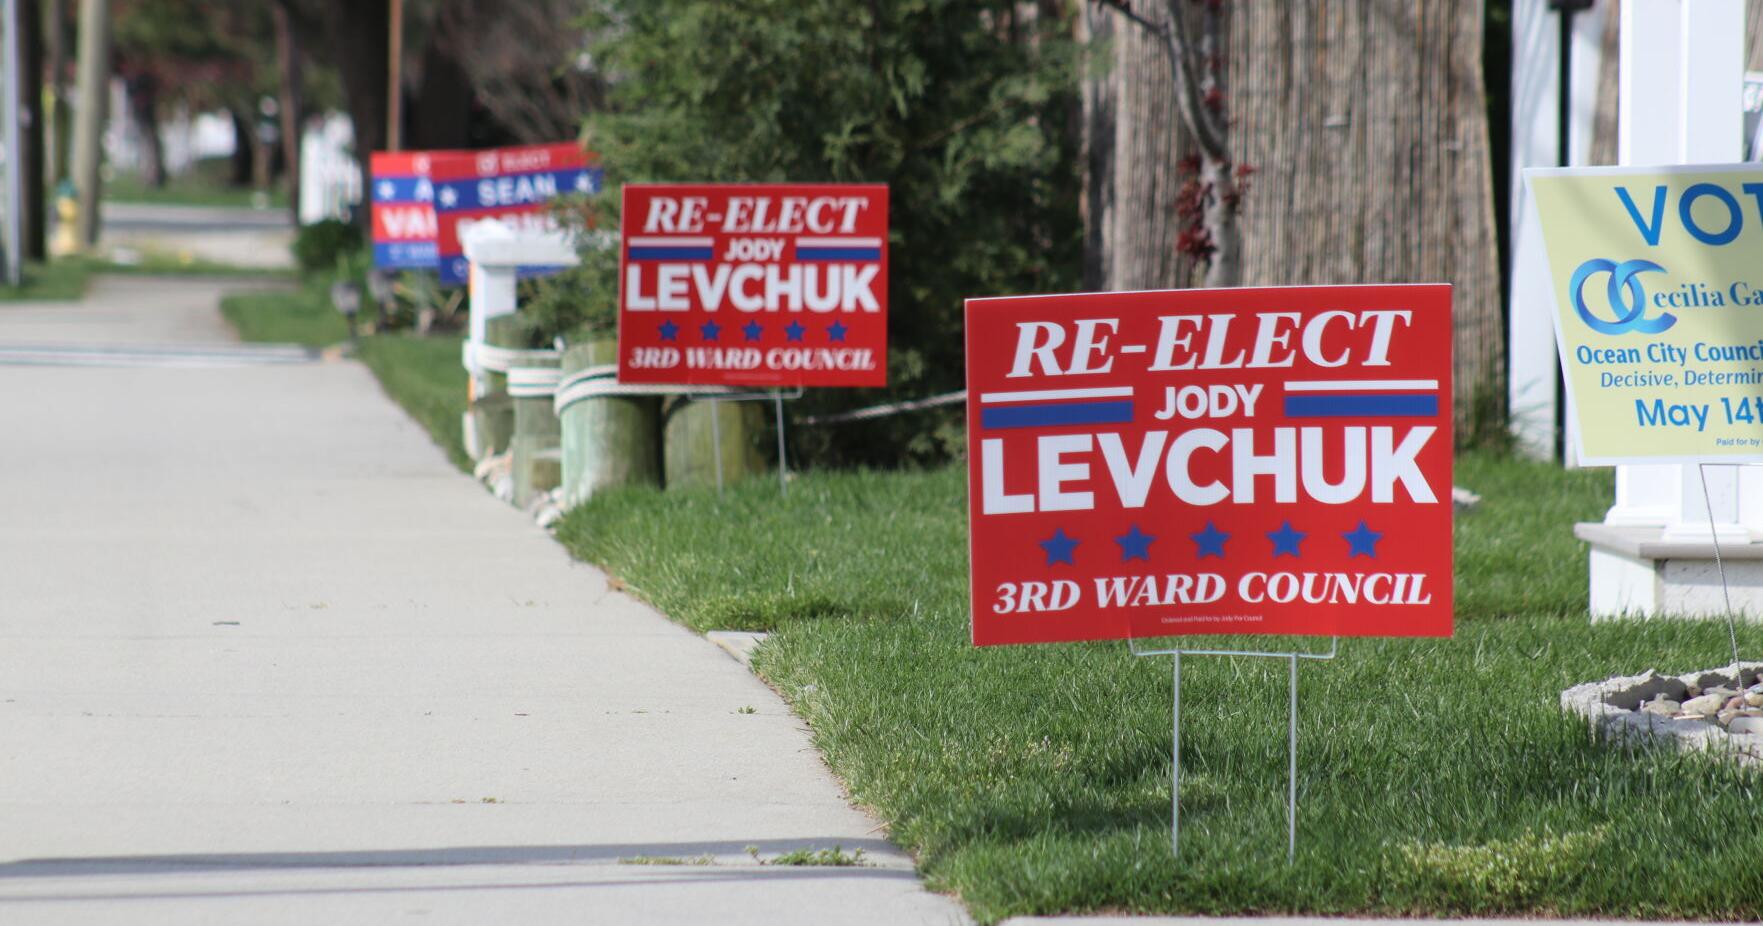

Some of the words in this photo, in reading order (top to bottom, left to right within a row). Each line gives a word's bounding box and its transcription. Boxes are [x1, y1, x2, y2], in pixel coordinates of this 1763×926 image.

[478, 172, 557, 207] SEAN
[643, 196, 868, 234] RE-ELECT
[724, 237, 786, 262] JODY
[625, 263, 881, 313] LEVCHUK
[629, 346, 680, 369] 3RD
[686, 347, 762, 369] WARD
[766, 347, 876, 370] COUNCIL
[1005, 309, 1413, 378] RE-ELECT
[1576, 345, 1641, 365] Ocean
[1647, 342, 1687, 366] City
[1600, 370, 1679, 389] Decisive,
[1154, 383, 1263, 420] JODY
[1635, 398, 1710, 431] May
[1716, 438, 1734, 446] Paid
[1737, 438, 1748, 446] for
[981, 426, 1439, 515] LEVCHUK
[992, 579, 1081, 614] 3RD
[1093, 572, 1227, 609] WARD
[1237, 571, 1432, 605] COUNCIL
